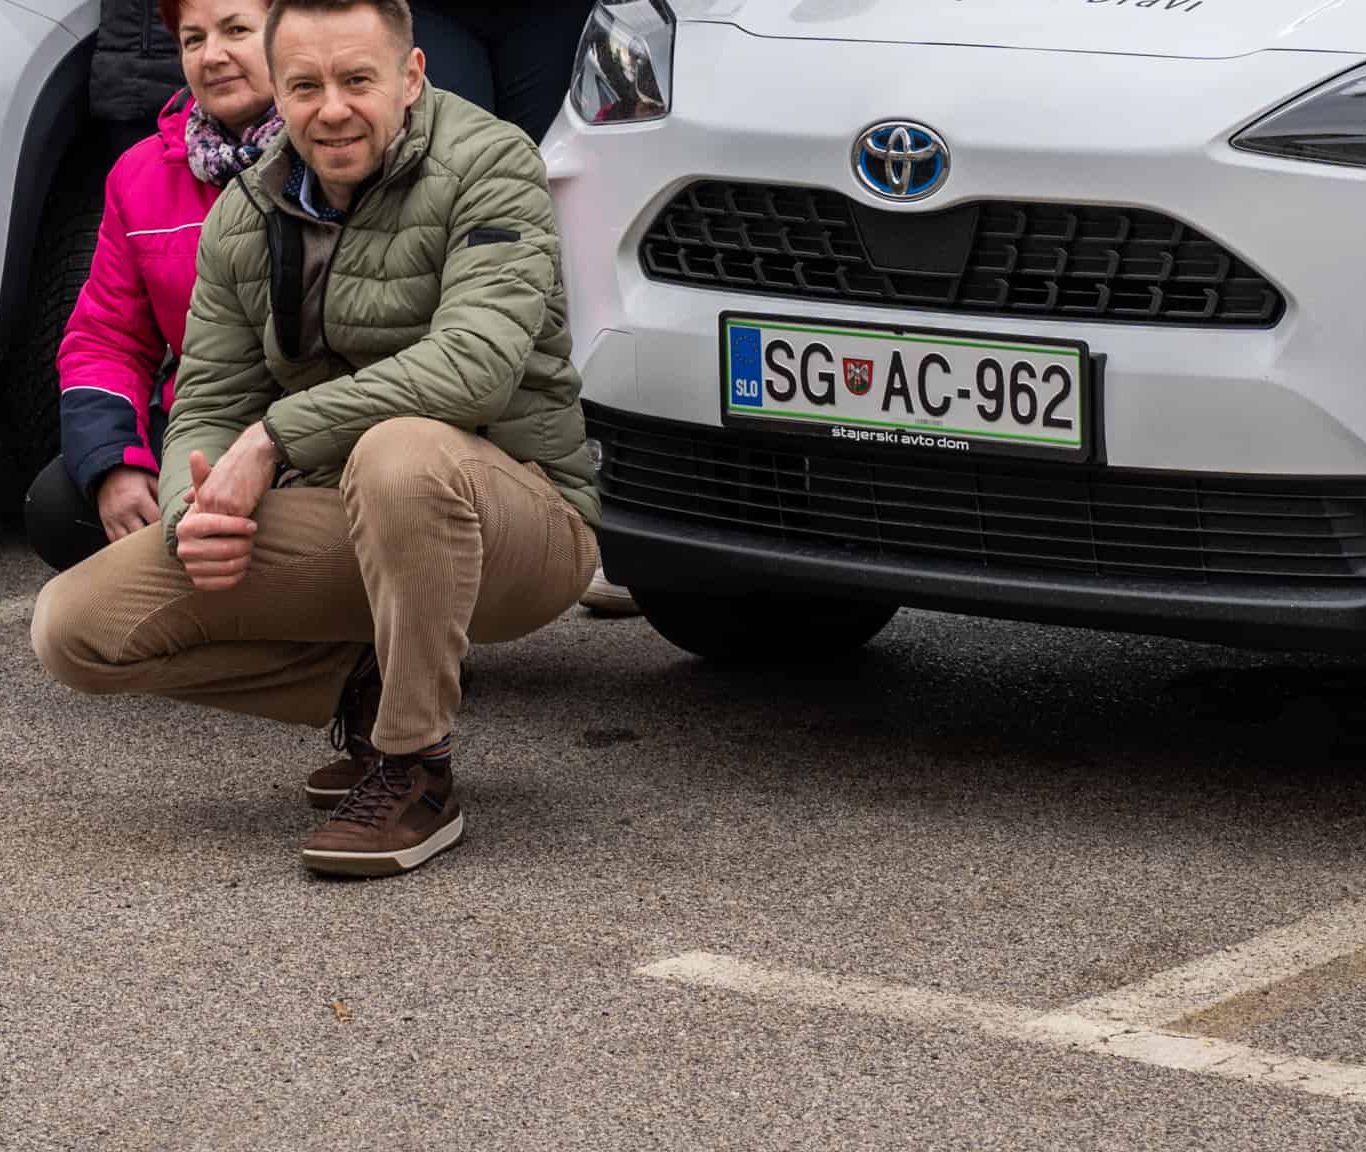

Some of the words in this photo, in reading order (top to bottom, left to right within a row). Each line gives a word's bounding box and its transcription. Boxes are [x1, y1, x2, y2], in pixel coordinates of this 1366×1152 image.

[735, 378, 759, 398] SLO
[764, 339, 836, 406] SG
[881, 350, 1073, 430] AC-962
[900, 434, 935, 447] avto
[937, 437, 970, 451] dom
